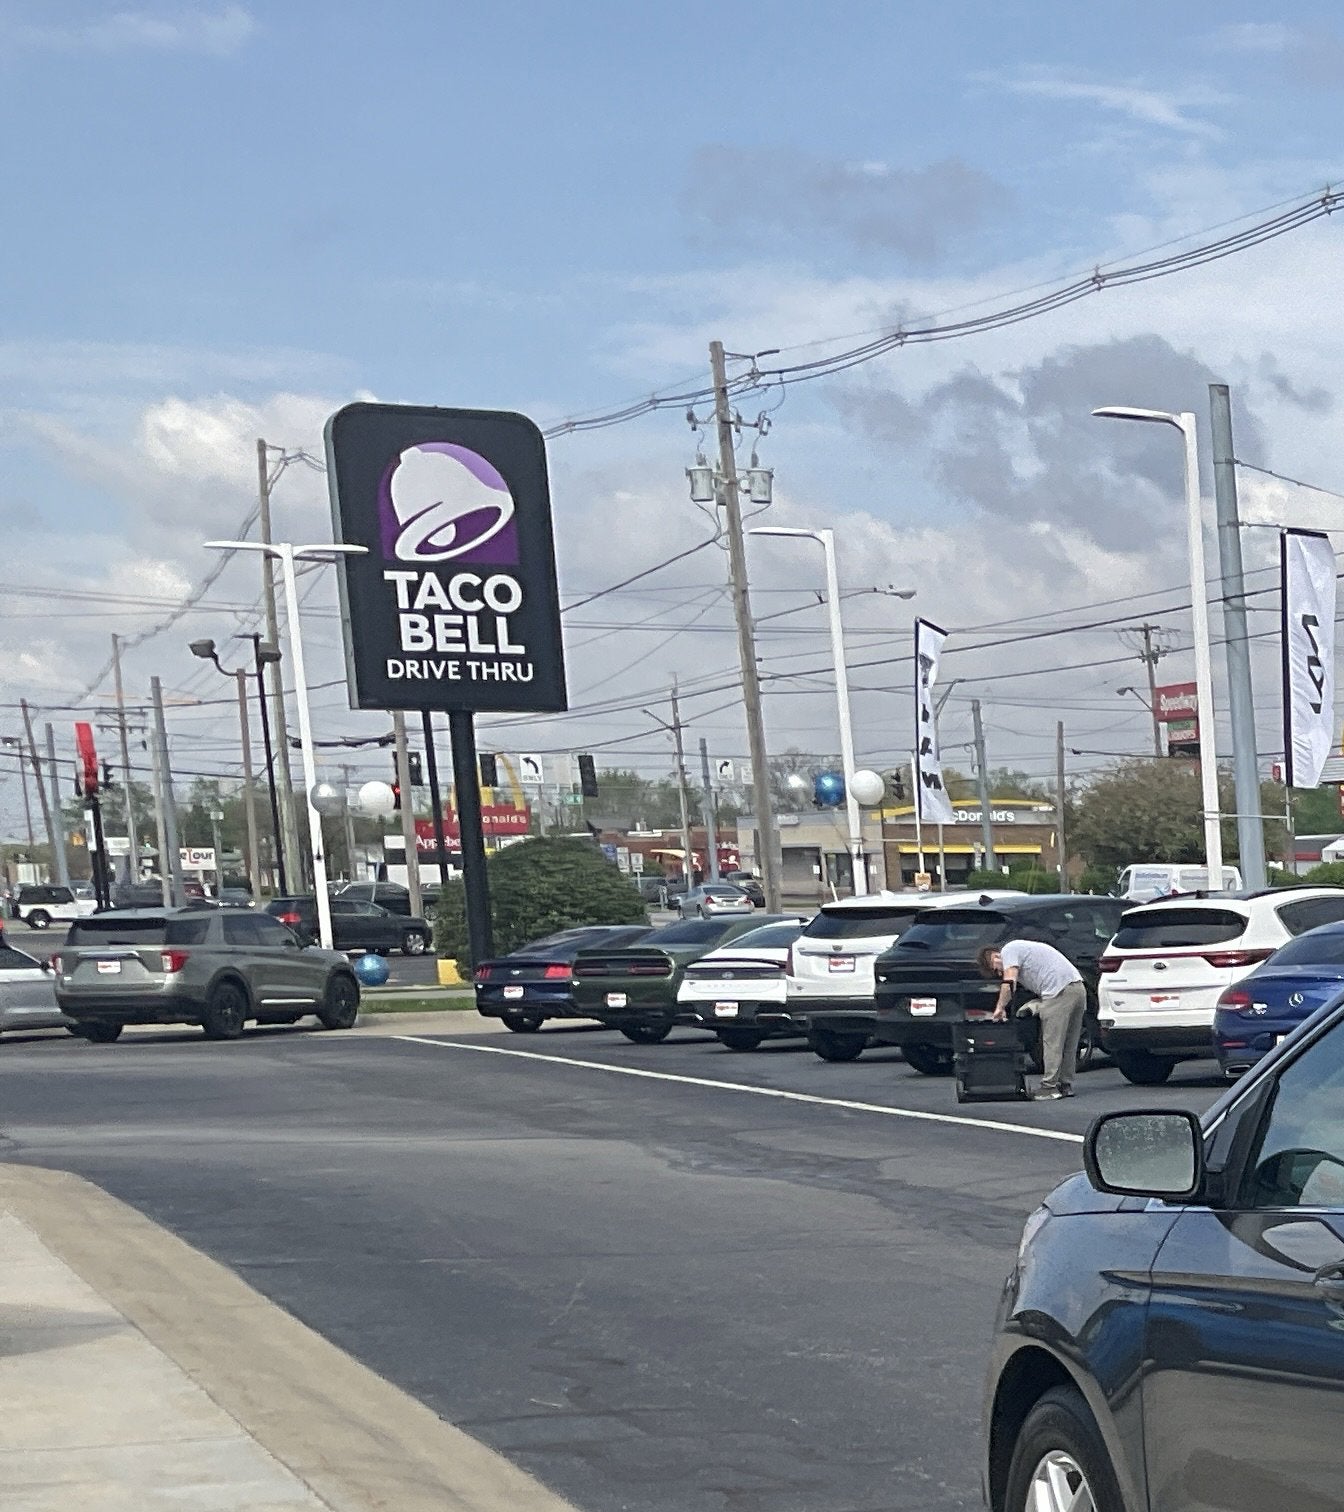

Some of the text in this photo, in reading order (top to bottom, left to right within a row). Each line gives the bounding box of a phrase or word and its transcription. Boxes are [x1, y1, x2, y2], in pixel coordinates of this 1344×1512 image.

[383, 570, 522, 613] TACO
[399, 613, 525, 654] BELL
[387, 658, 534, 682] DRIVE THRU
